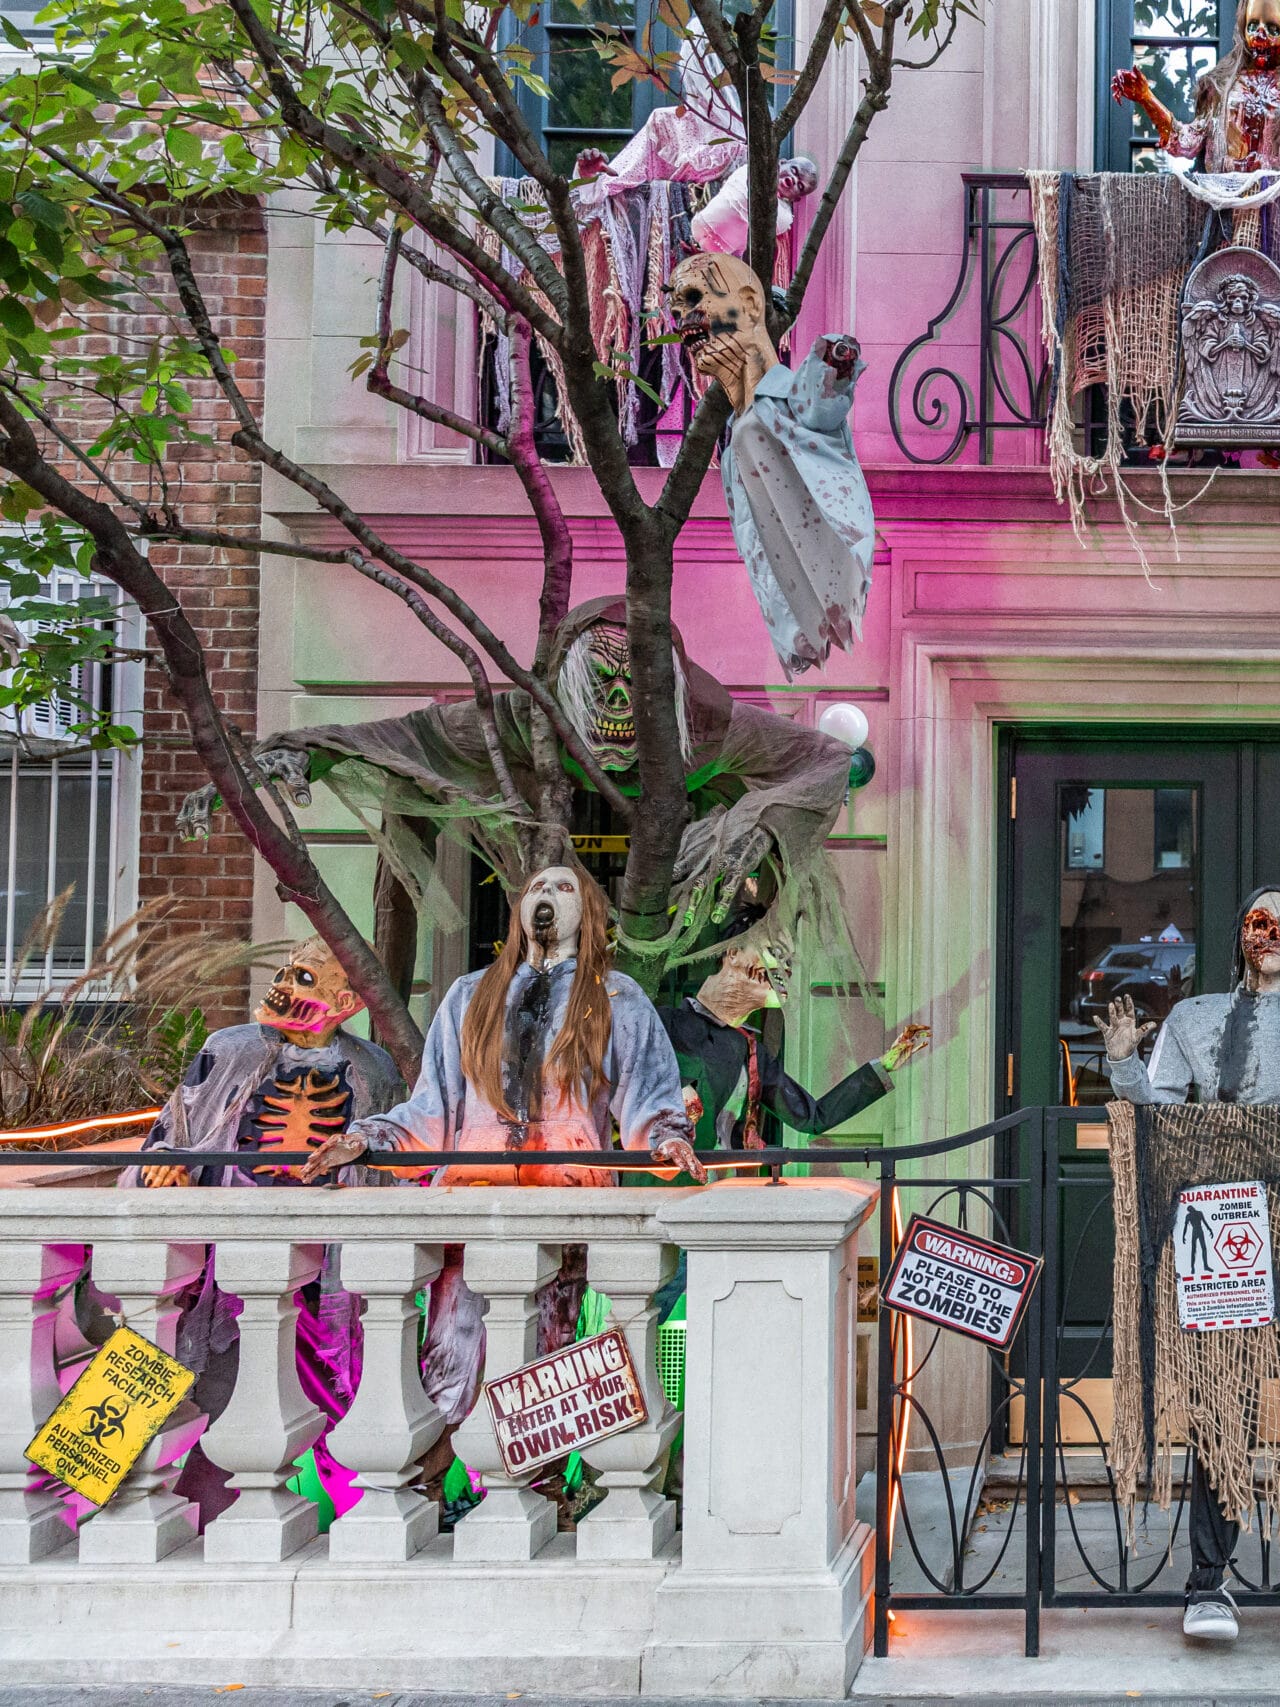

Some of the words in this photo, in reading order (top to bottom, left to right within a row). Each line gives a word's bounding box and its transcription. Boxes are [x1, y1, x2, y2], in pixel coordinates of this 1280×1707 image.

[1179, 1187, 1258, 1204] QUARANTINE
[1211, 1210, 1260, 1221] OUTBREAK
[1219, 1201, 1252, 1211] ZOMBIE
[916, 1259, 975, 1290] PLEASE
[978, 1284, 1002, 1300] DO
[925, 1234, 1015, 1282] WARNING:
[901, 1268, 934, 1288] NOT
[936, 1281, 977, 1304] FEED
[983, 1298, 1013, 1319] THE
[1184, 1280, 1239, 1293] RESTRICTED
[1241, 1278, 1266, 1289] AREA
[1217, 1296, 1255, 1304] QUARANTINED
[897, 1281, 1003, 1335] ZOMBIES
[105, 1350, 176, 1403] RESEARCH
[124, 1343, 176, 1384] ZOMBIE
[492, 1337, 624, 1416] WARNING
[102, 1368, 159, 1409] FACILITY
[508, 1404, 557, 1437] ENTER
[560, 1394, 579, 1416] AT
[582, 1374, 625, 1405] YOUR
[51, 1423, 121, 1474] AUTHORIZED
[507, 1422, 570, 1466] OWN
[574, 1394, 637, 1438] RISK!
[45, 1434, 110, 1484] PERSONNEL
[56, 1457, 90, 1482] ONLY
